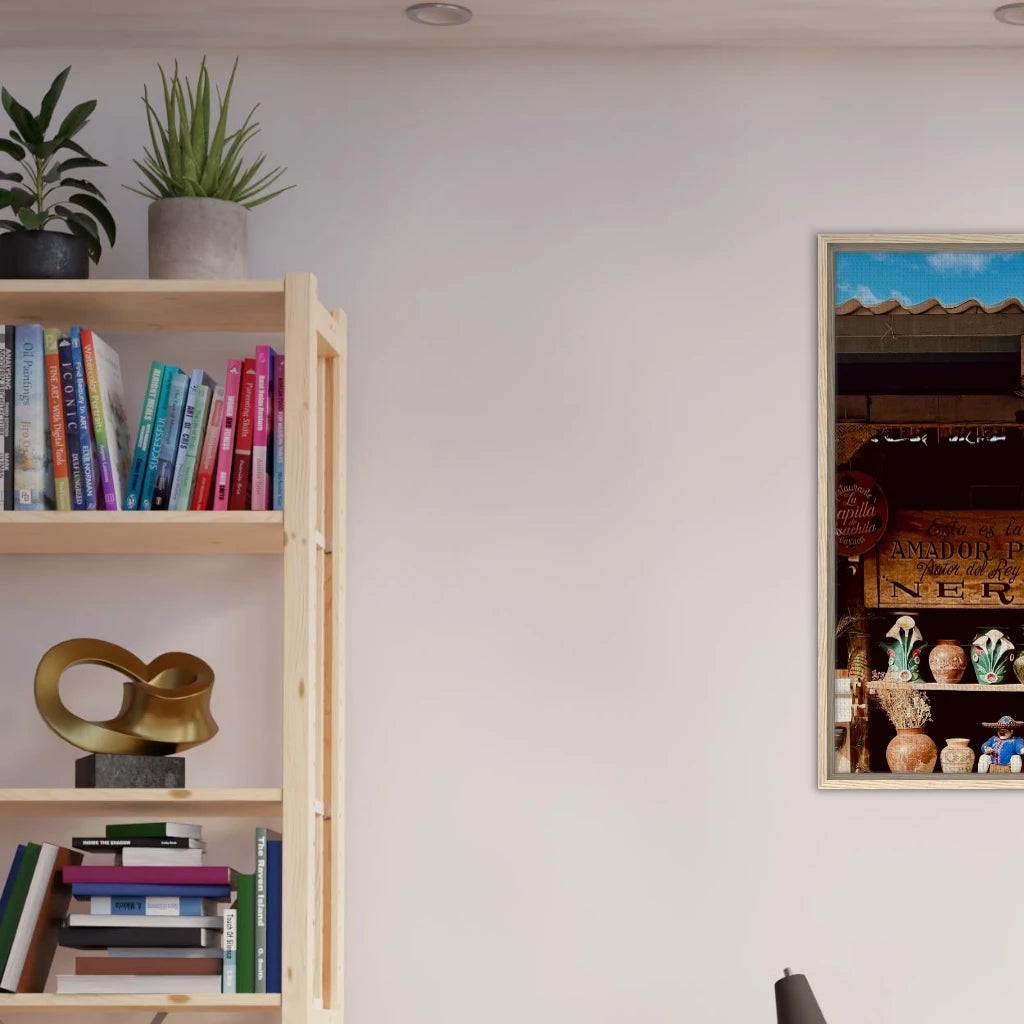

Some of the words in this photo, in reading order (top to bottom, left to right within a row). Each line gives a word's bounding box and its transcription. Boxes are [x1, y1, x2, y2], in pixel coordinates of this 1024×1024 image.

[23, 342, 34, 357] Oil
[49, 365, 58, 383] FINE
[75, 361, 83, 377] Find
[20, 360, 33, 406] Paintings
[51, 385, 60, 399] ART
[77, 378, 86, 405] Beauty
[84, 343, 97, 392] Watercolor
[92, 394, 104, 433] Portraits
[61, 362, 78, 430] ICONIC
[242, 382, 254, 419] Parenting
[52, 404, 62, 424] With
[80, 415, 88, 430] ART
[52, 423, 64, 447] Digital
[55, 449, 65, 466] Tools
[84, 464, 93, 497] NORMAN
[836, 501, 876, 526] apilla
[927, 518, 967, 537] Esta
[978, 524, 995, 538] es
[1005, 517, 1023, 536] la
[889, 540, 993, 561] AMADOR
[917, 558, 960, 582] Autor
[966, 559, 988, 577] del
[988, 558, 1021, 583] Rey
[257, 836, 265, 857] The
[257, 859, 265, 892] Raven
[257, 894, 265, 927] Island
[225, 913, 234, 931] Touch
